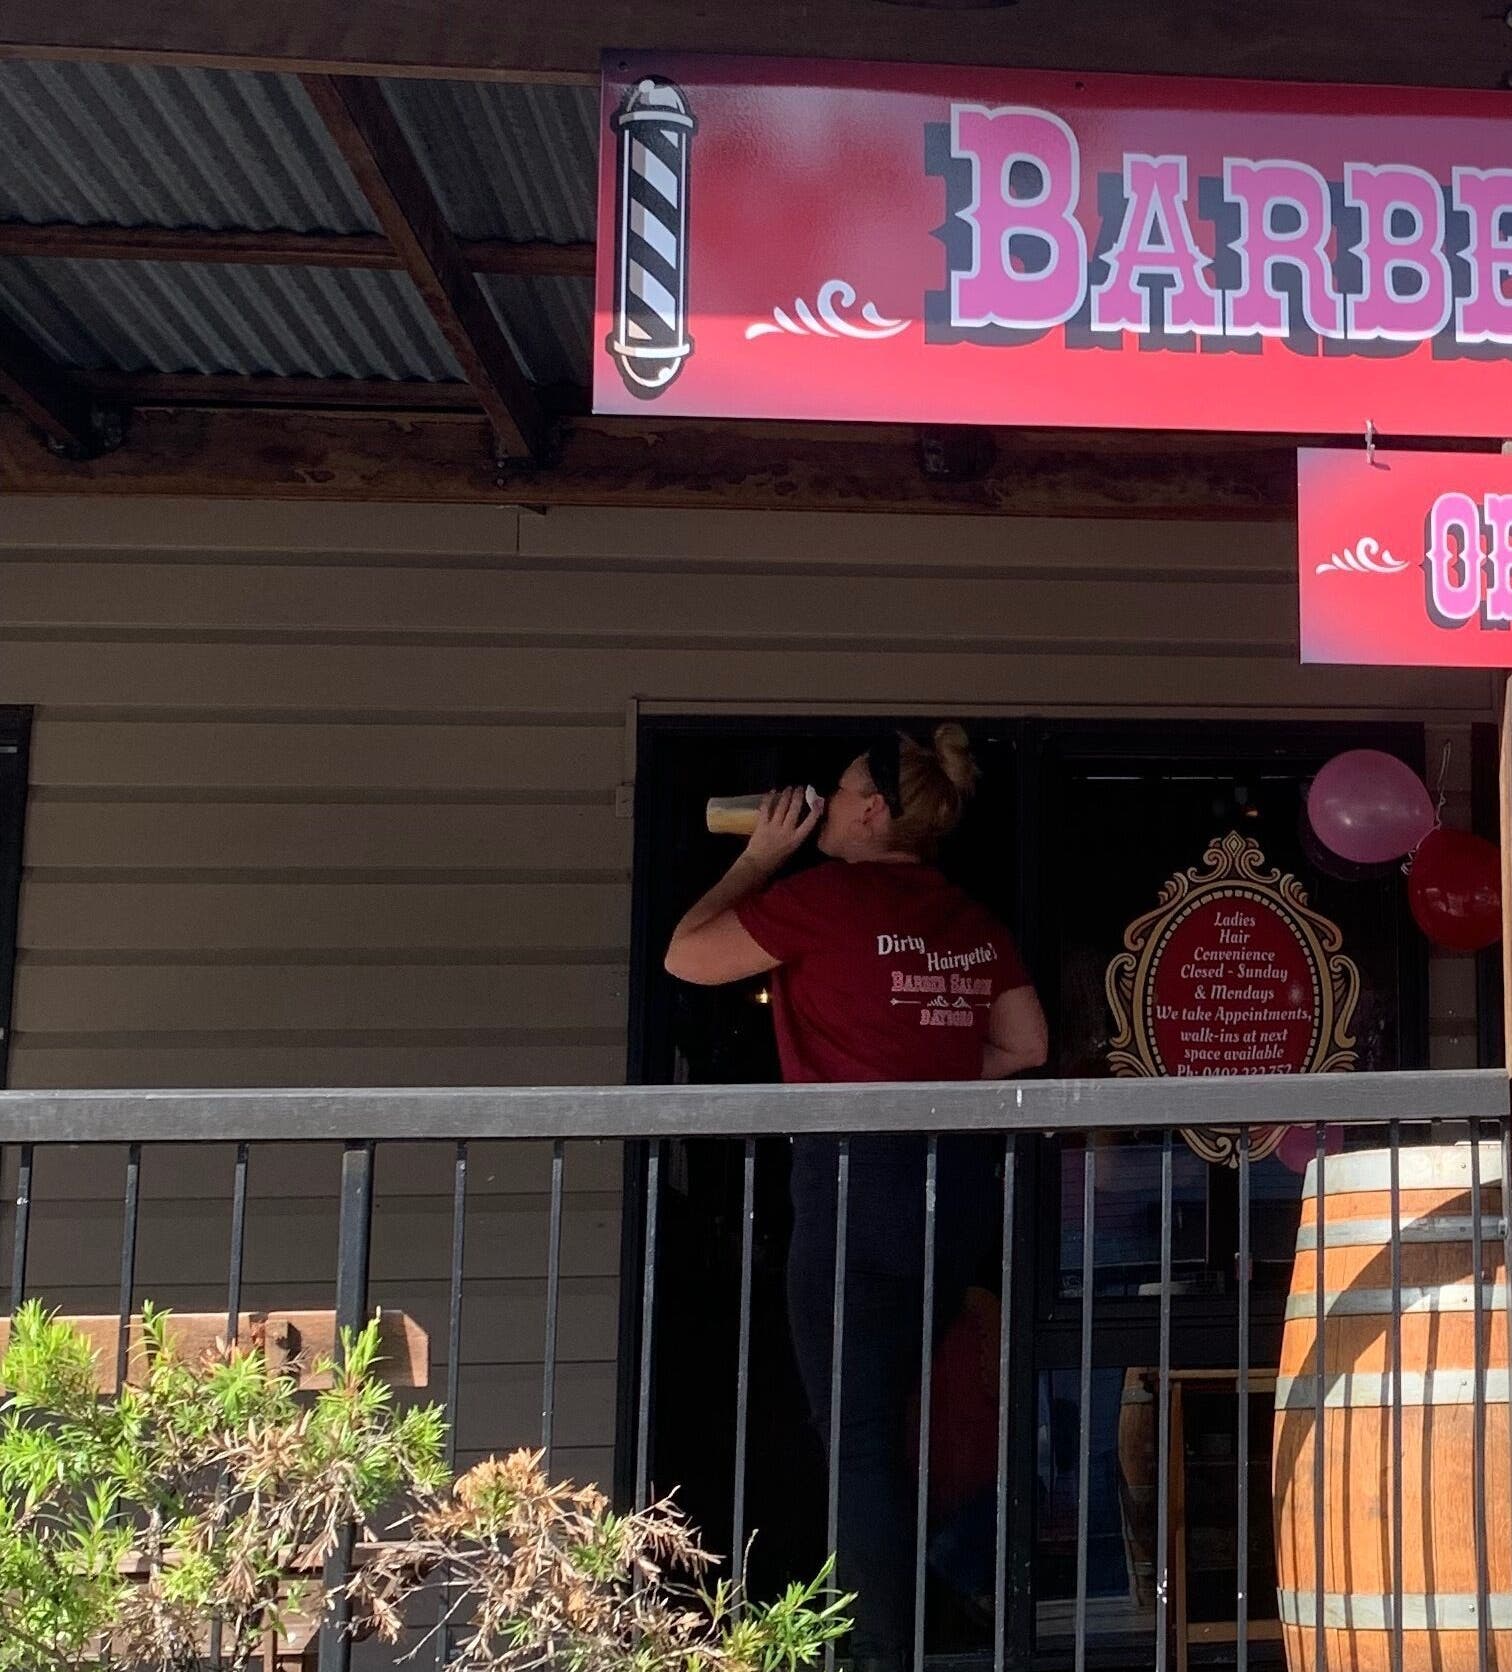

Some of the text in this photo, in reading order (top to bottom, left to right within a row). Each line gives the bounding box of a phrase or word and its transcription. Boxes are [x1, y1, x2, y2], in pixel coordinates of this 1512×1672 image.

[1213, 911, 1256, 927] Ladies
[876, 933, 925, 955] Dirty
[1219, 929, 1250, 943] Hair
[1193, 946, 1275, 961] Convenience
[1180, 963, 1223, 979] Closed
[1237, 964, 1288, 982] Sunday
[1194, 984, 1274, 1003] & Mondays
[1156, 1005, 1311, 1024] We take Appointments,
[1180, 1028, 1287, 1043] walk-ins at next
[1183, 1044, 1284, 1062] space available
